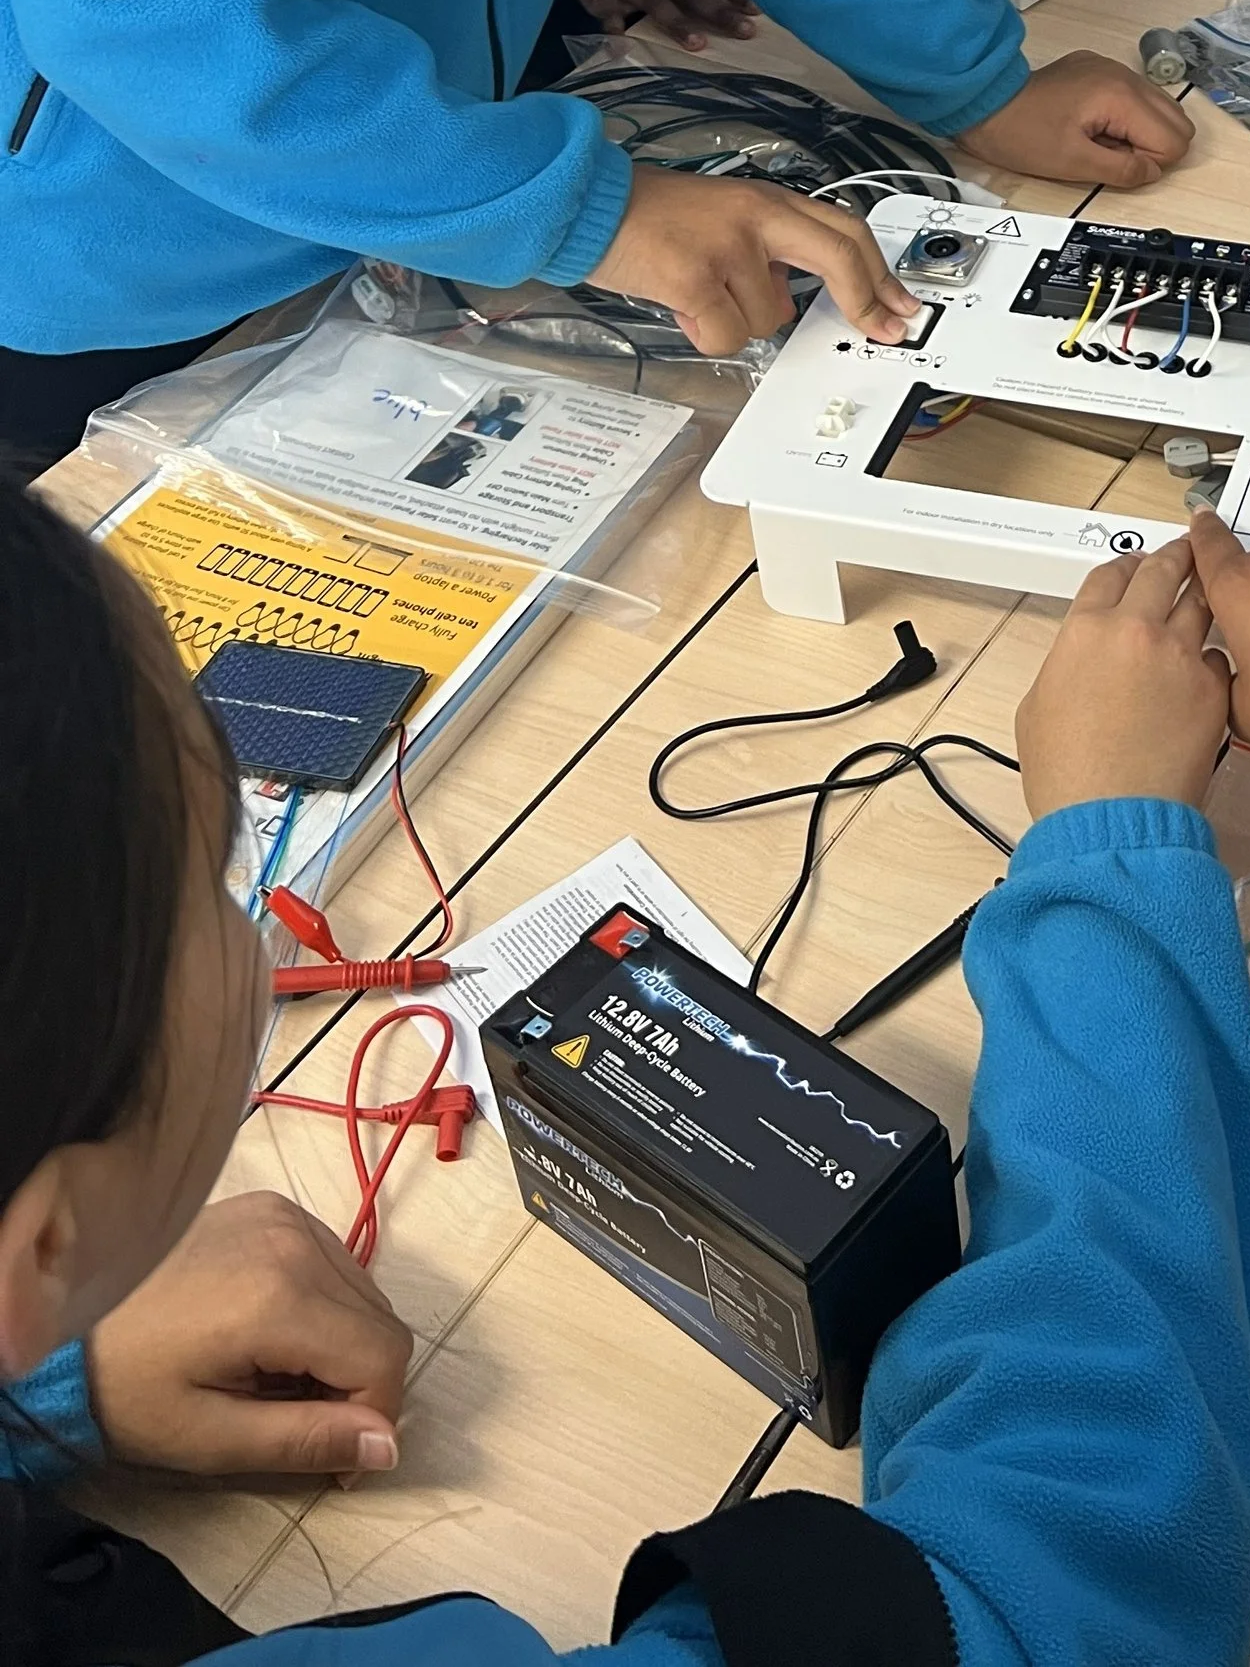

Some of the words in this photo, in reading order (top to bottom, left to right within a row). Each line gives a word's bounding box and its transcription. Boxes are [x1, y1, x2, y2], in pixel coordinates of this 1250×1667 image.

[358, 386, 433, 424] blue
[321, 447, 355, 460] Contact
[485, 482, 502, 490] OFF
[523, 474, 552, 486] Battery
[503, 486, 529, 497] Switch
[552, 481, 581, 494] Unplug
[477, 491, 511, 505] Storage
[529, 493, 550, 502] Main
[390, 504, 416, 515] Panel
[510, 500, 530, 509] and
[416, 511, 438, 521] Solar
[480, 516, 499, 525] with
[530, 505, 574, 523] Transport
[136, 520, 159, 533] charge
[499, 522, 533, 534] sunlight
[915, 510, 940, 519] indoor
[940, 514, 981, 525] installation
[989, 521, 1003, 529] dry
[1003, 523, 1037, 534] locations
[1038, 529, 1055, 537] only
[249, 531, 270, 539] about
[533, 530, 559, 542] direct
[148, 544, 169, 555] phone
[164, 539, 183, 548] store
[528, 541, 551, 552] Solar
[420, 558, 452, 574] hours
[413, 572, 449, 590] laptop
[462, 570, 475, 580] to
[450, 583, 460, 591] a
[494, 580, 514, 592] for
[459, 587, 496, 602] Power
[392, 598, 436, 615] phones
[389, 614, 428, 630] charge
[433, 611, 457, 621] cell
[457, 617, 478, 629] ten
[428, 624, 457, 640] Fully
[631, 965, 730, 1037] POWERTECH
[602, 995, 651, 1032] 12.8V
[645, 1025, 678, 1055] 7Ah
[682, 1017, 714, 1041] Lithium
[588, 1010, 623, 1038] Lithium
[622, 1034, 670, 1071] Deep-Cycle
[670, 1067, 705, 1097] Battery
[506, 1094, 624, 1194] POWERTECH
[585, 1166, 624, 1199] Lithium
[564, 1172, 596, 1207] 7Ah
[610, 1221, 645, 1253] Battery
